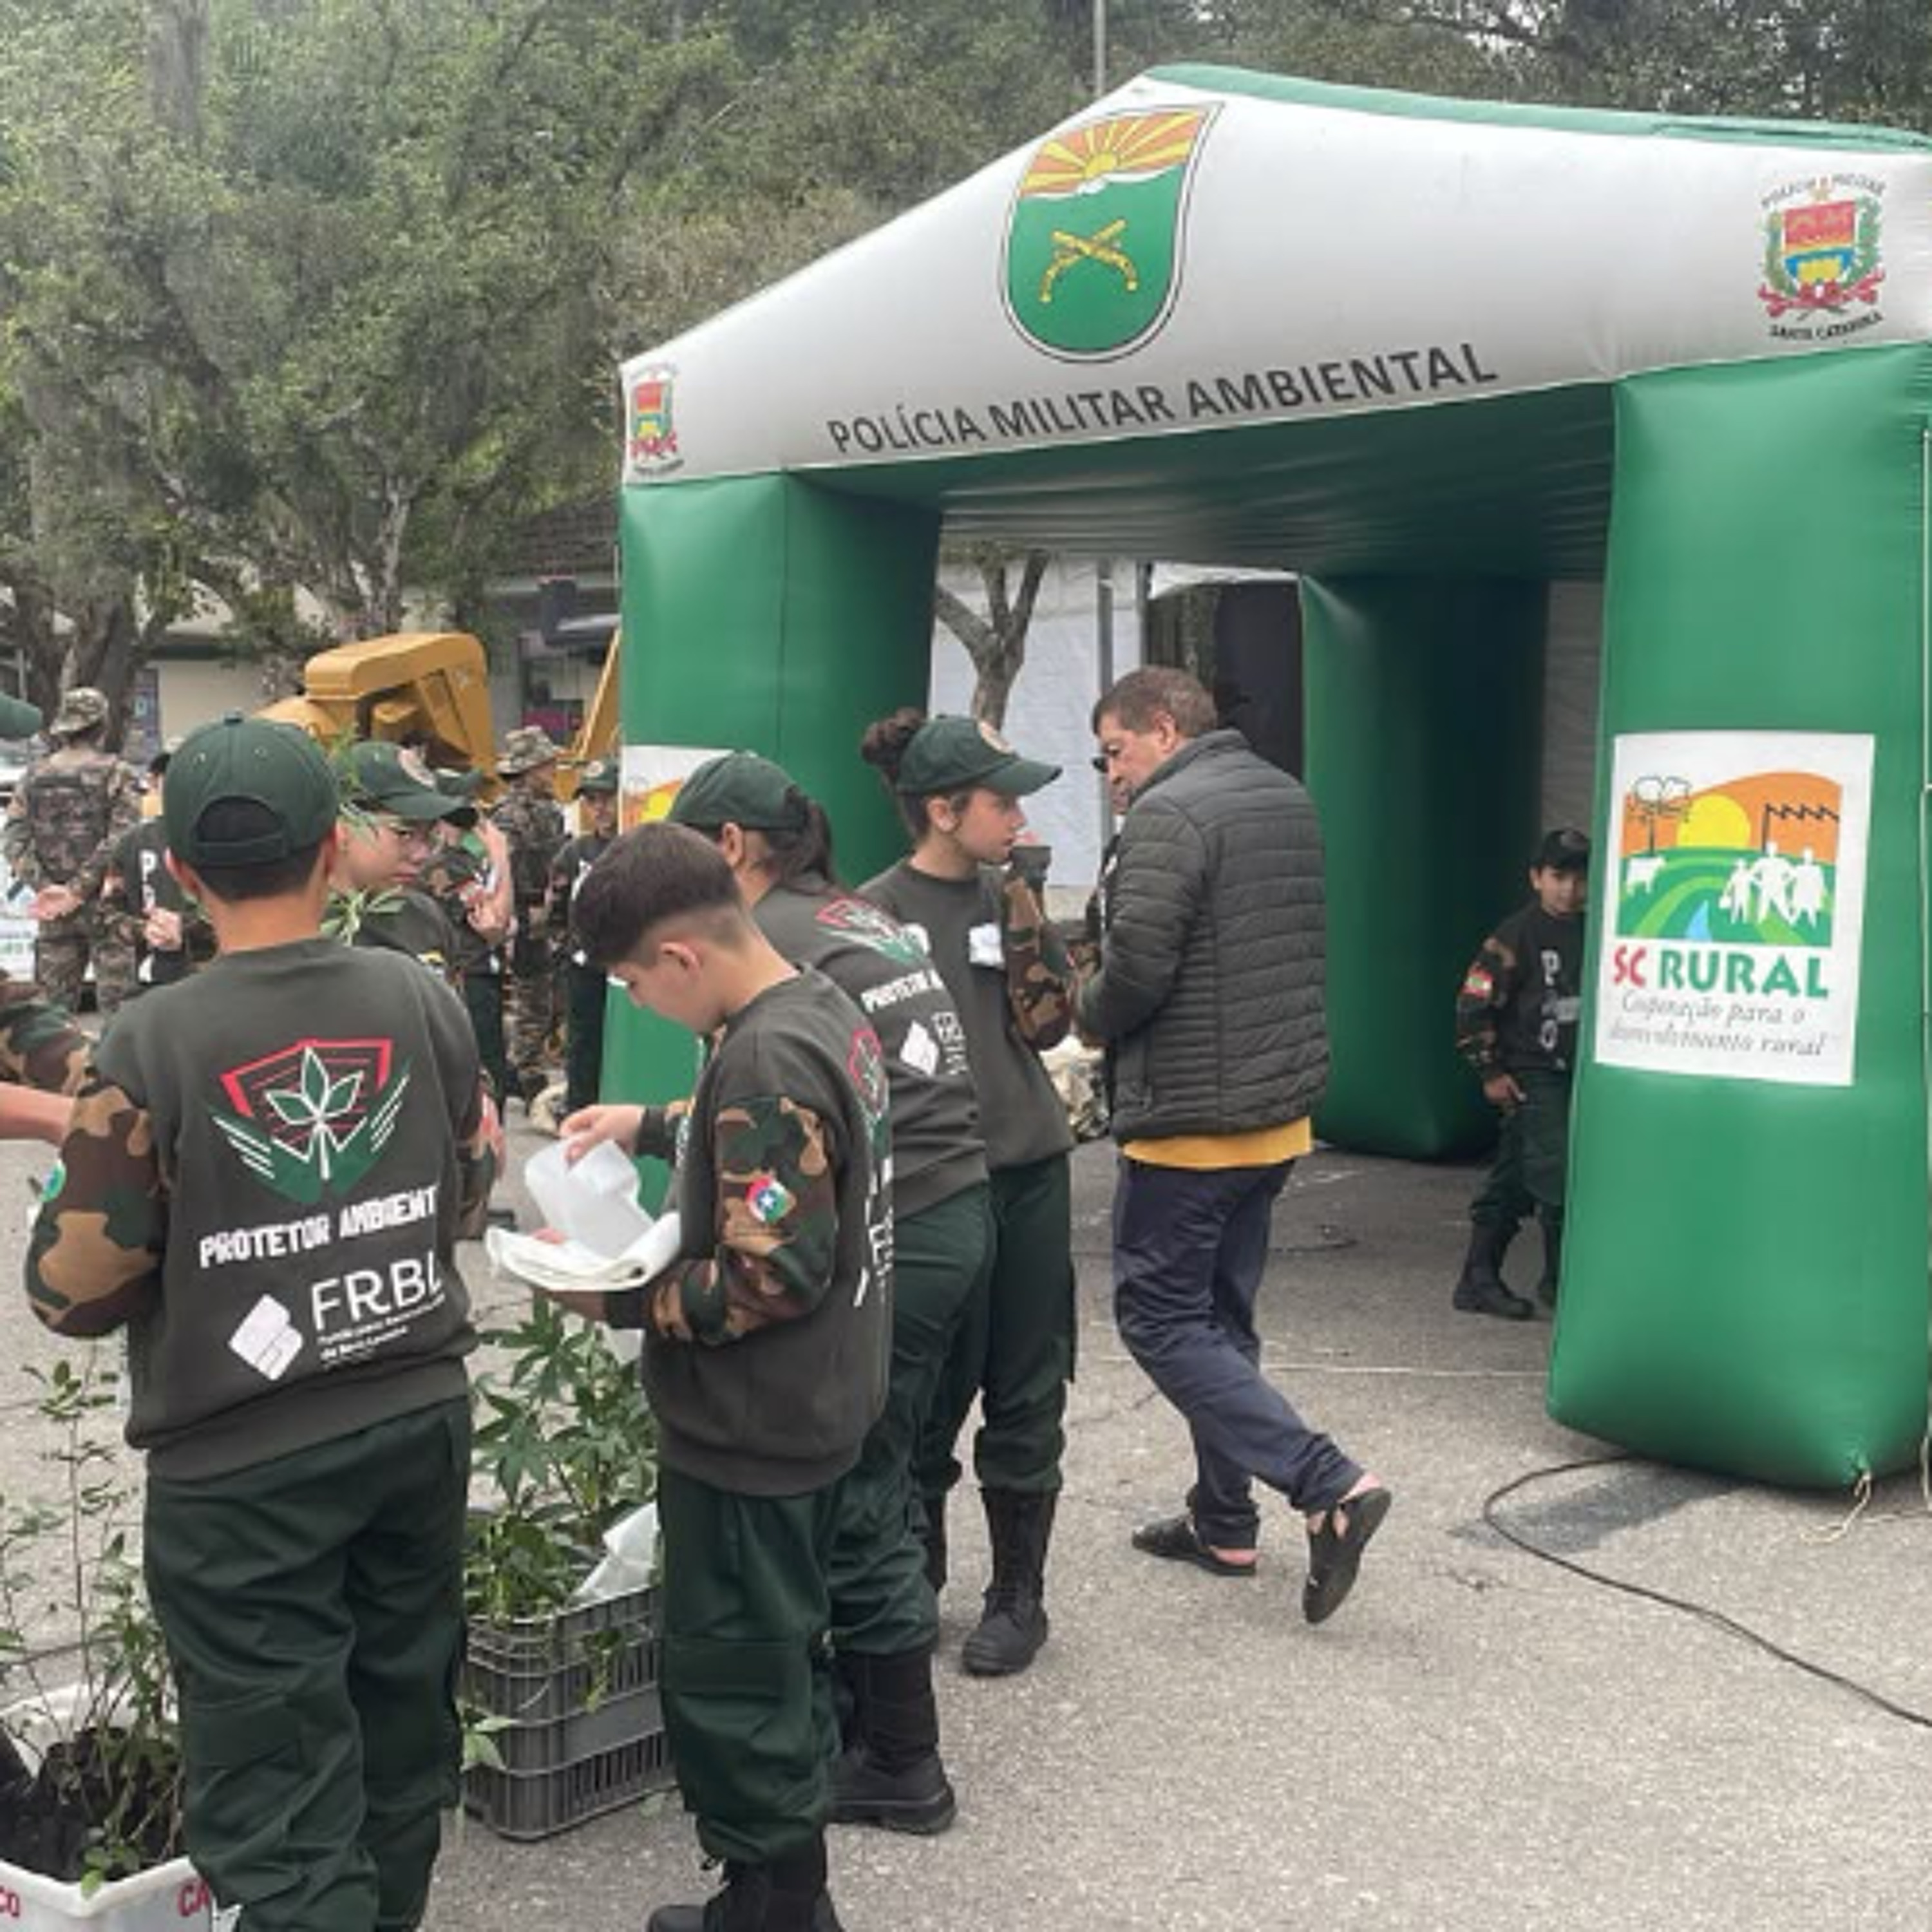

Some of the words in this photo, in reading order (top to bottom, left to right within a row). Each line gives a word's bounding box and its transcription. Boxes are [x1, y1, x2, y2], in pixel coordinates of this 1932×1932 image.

[827, 404, 987, 453] POLÍCIA
[988, 385, 1175, 439] MILITAR
[1186, 343, 1499, 417] AMBIENTAL
[1613, 945, 1647, 987] SC
[1660, 950, 1829, 999] RURAL
[1727, 1003, 1783, 1028] para
[1792, 1009, 1805, 1025] o
[199, 1213, 330, 1269] PROTETOR
[312, 1249, 444, 1331] FRBL
